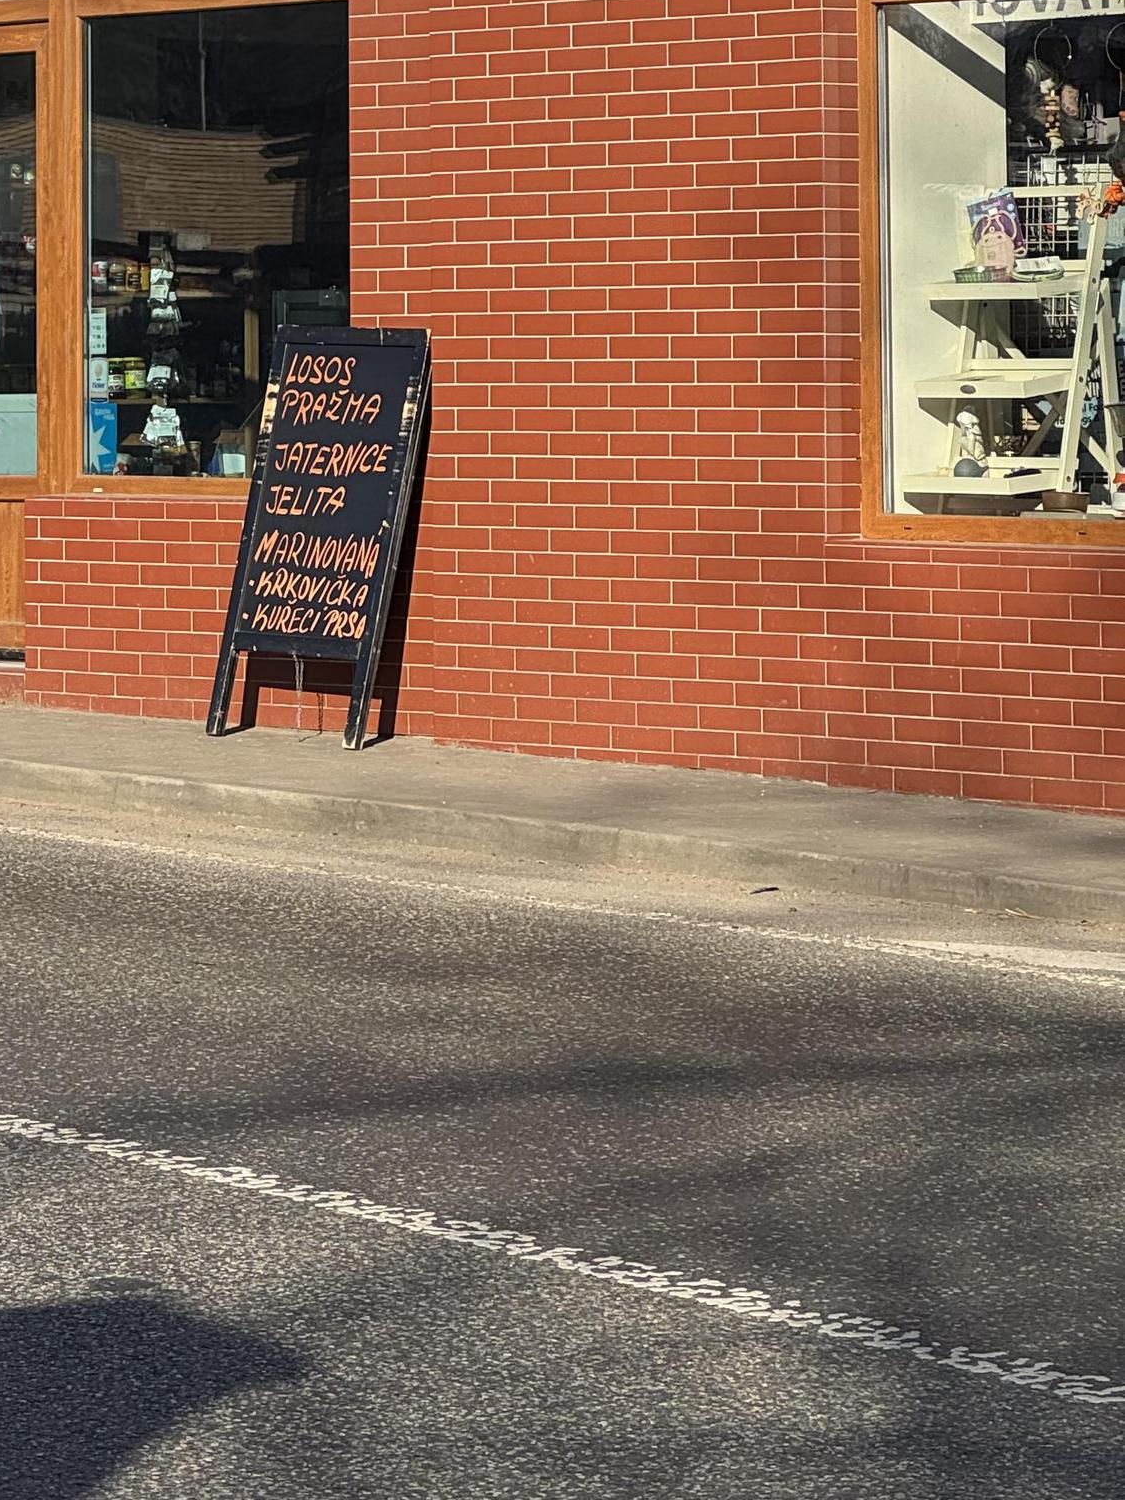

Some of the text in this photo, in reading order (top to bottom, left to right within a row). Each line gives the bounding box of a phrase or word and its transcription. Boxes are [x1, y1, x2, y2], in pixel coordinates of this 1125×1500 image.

[285, 352, 357, 386] LOSOS
[281, 389, 382, 427] PRAŽMA
[275, 440, 394, 478] JATERNICE
[266, 484, 346, 517] JELITA
[322, 608, 368, 639] PRSA
